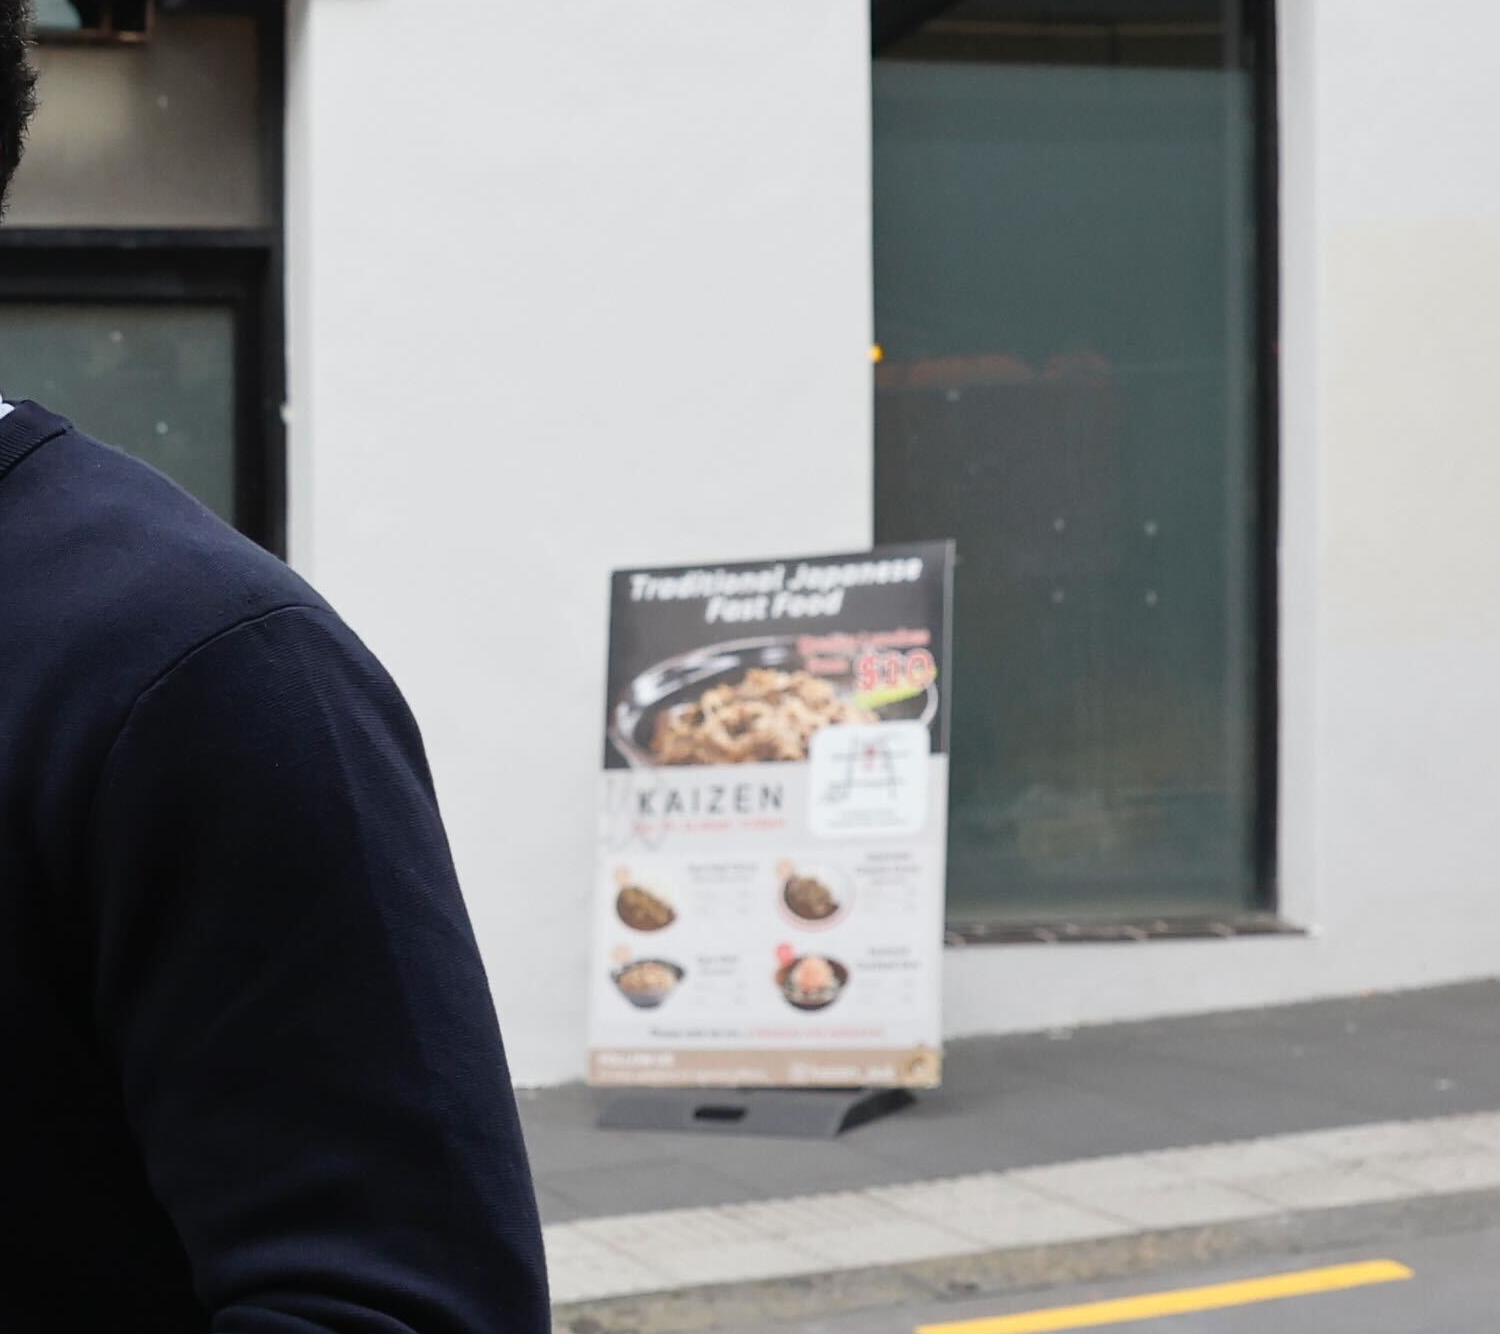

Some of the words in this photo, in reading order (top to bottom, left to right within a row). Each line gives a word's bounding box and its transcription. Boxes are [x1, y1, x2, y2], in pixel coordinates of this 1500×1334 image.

[630, 565, 786, 602] Traditional
[788, 556, 923, 592] Japanese
[705, 595, 769, 624] Fast
[771, 590, 843, 618] Food
[637, 783, 785, 816] KAIZEN
